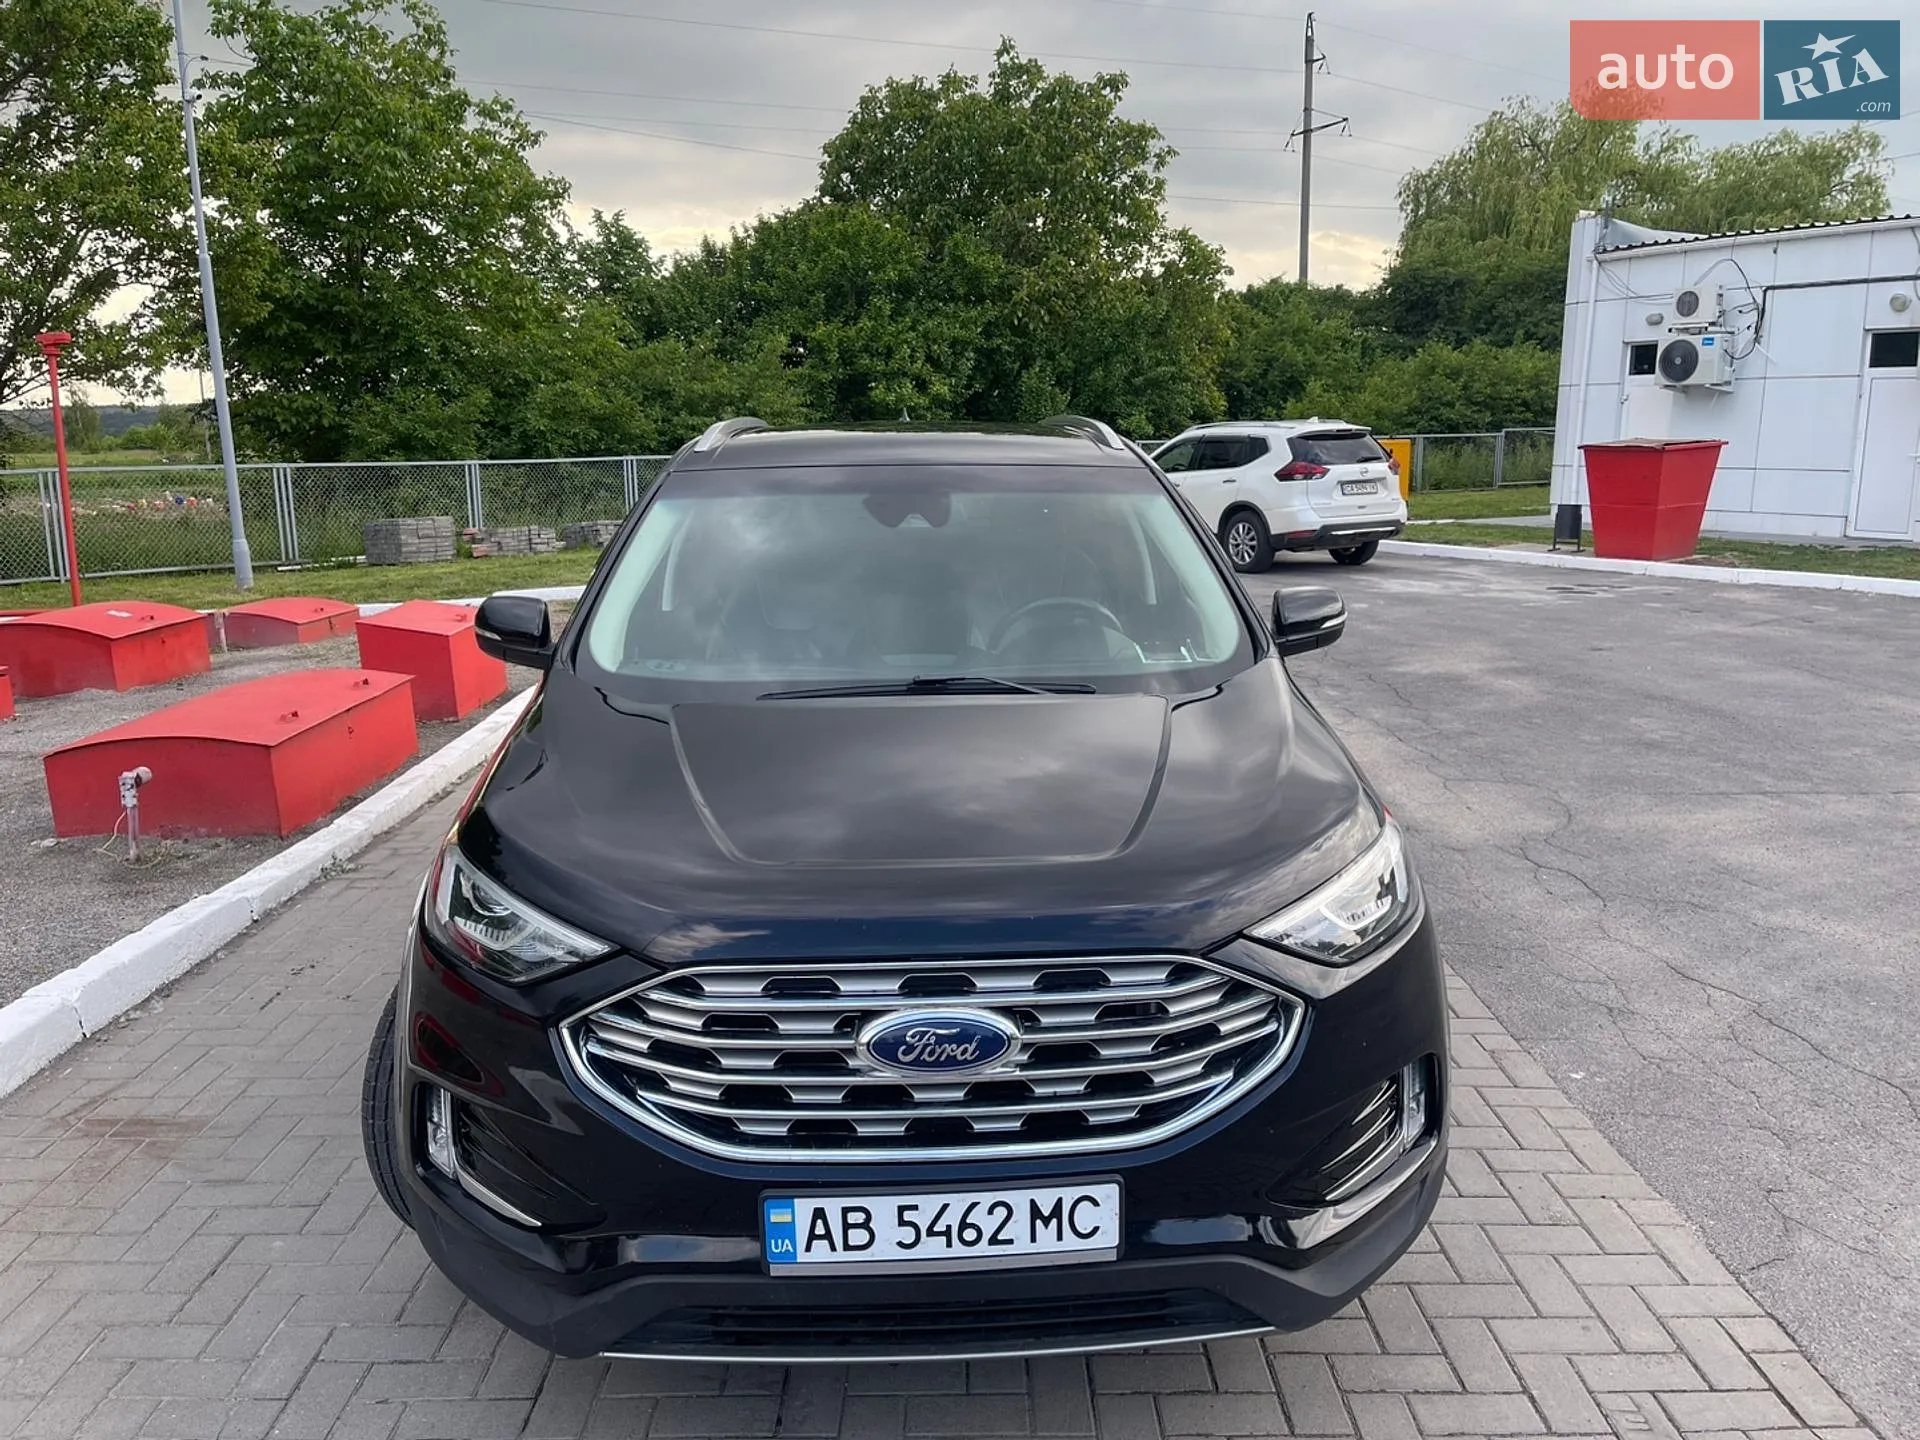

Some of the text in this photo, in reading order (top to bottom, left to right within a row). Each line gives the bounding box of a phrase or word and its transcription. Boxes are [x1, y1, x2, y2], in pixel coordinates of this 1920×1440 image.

[897, 1027, 981, 1063] Ford
[804, 1194, 1101, 1253] AB 5462 MC
[771, 1239, 793, 1253] UA
